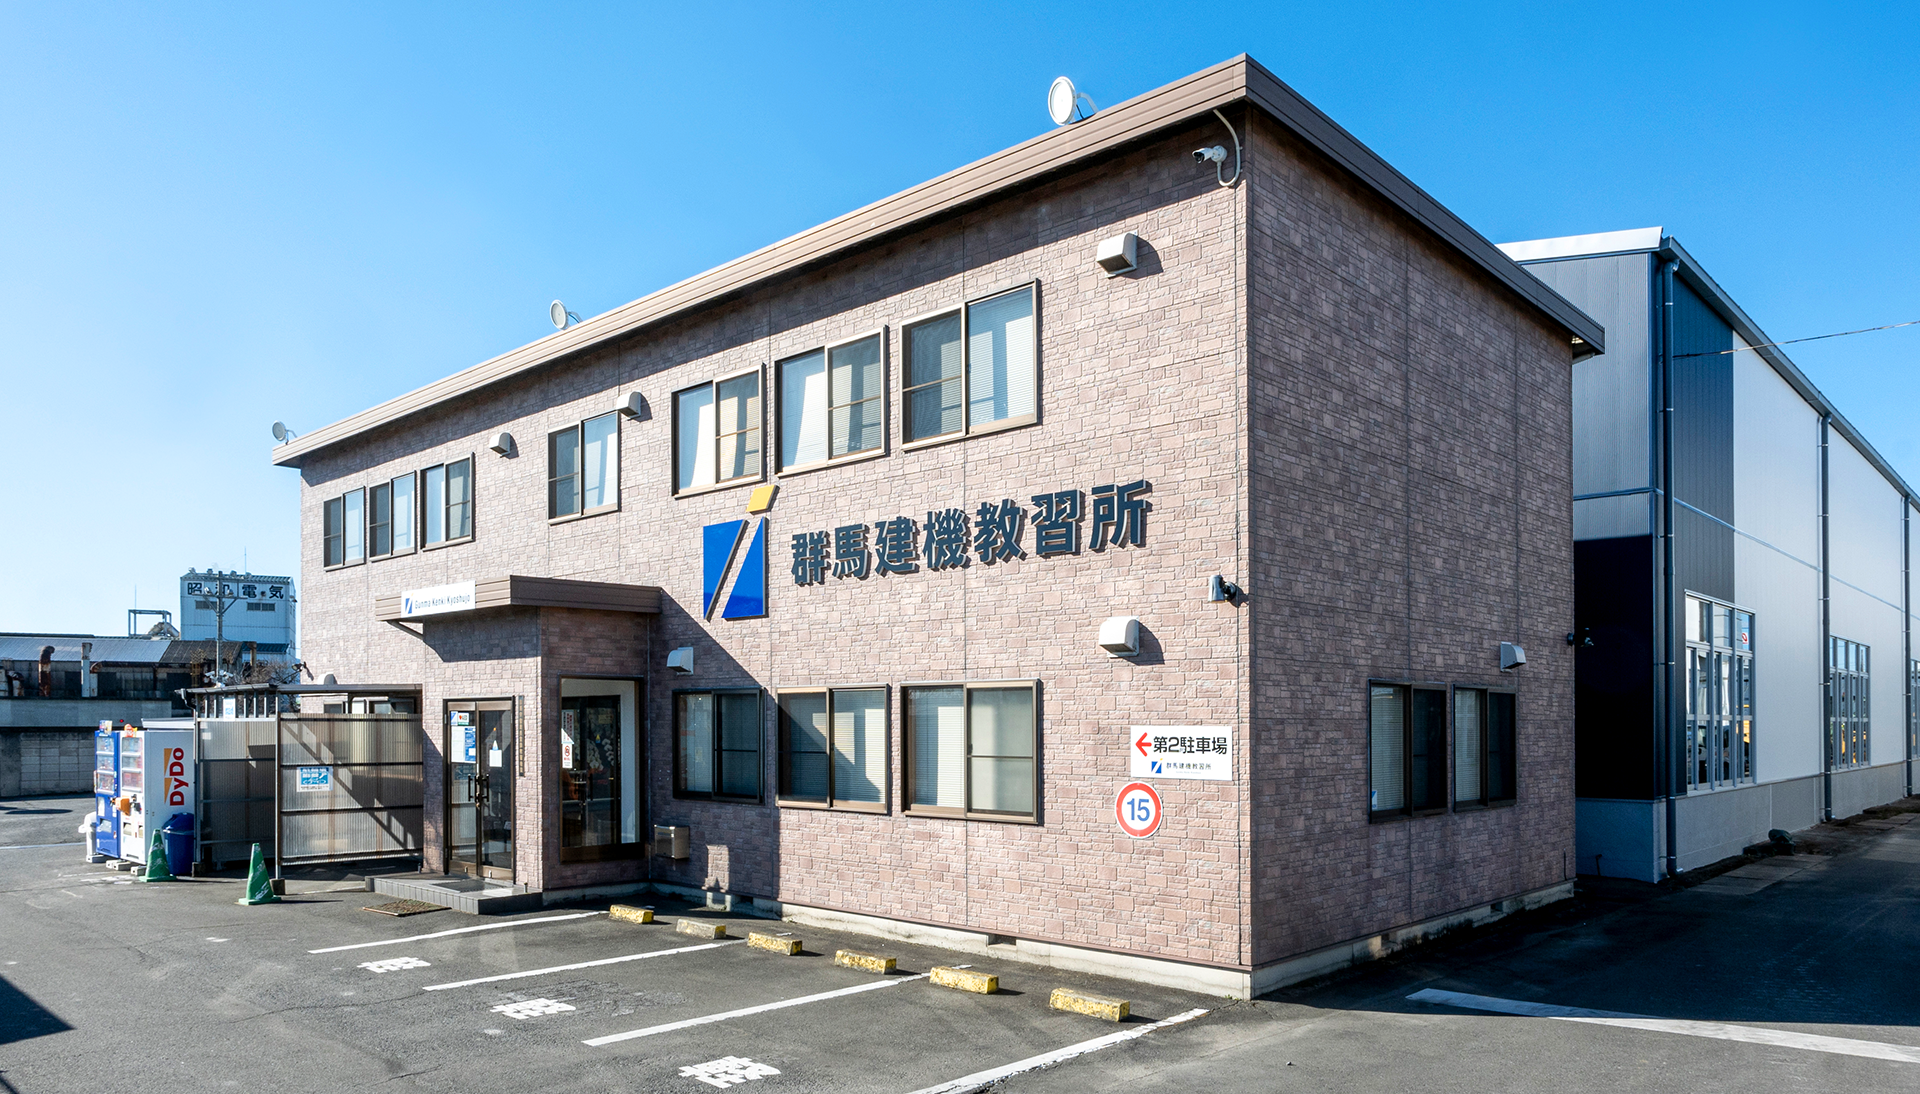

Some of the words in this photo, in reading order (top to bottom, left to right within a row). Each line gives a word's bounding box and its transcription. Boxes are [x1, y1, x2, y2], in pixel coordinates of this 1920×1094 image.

[790, 479, 1149, 586] 群馬建機教習所
[414, 599, 431, 609] Gunma
[432, 596, 446, 606] Kenki
[446, 593, 471, 606] Kyoshujo
[1153, 736, 1228, 755] 第2駐車場
[169, 747, 189, 806] DyDo
[1126, 798, 1150, 822] 15
